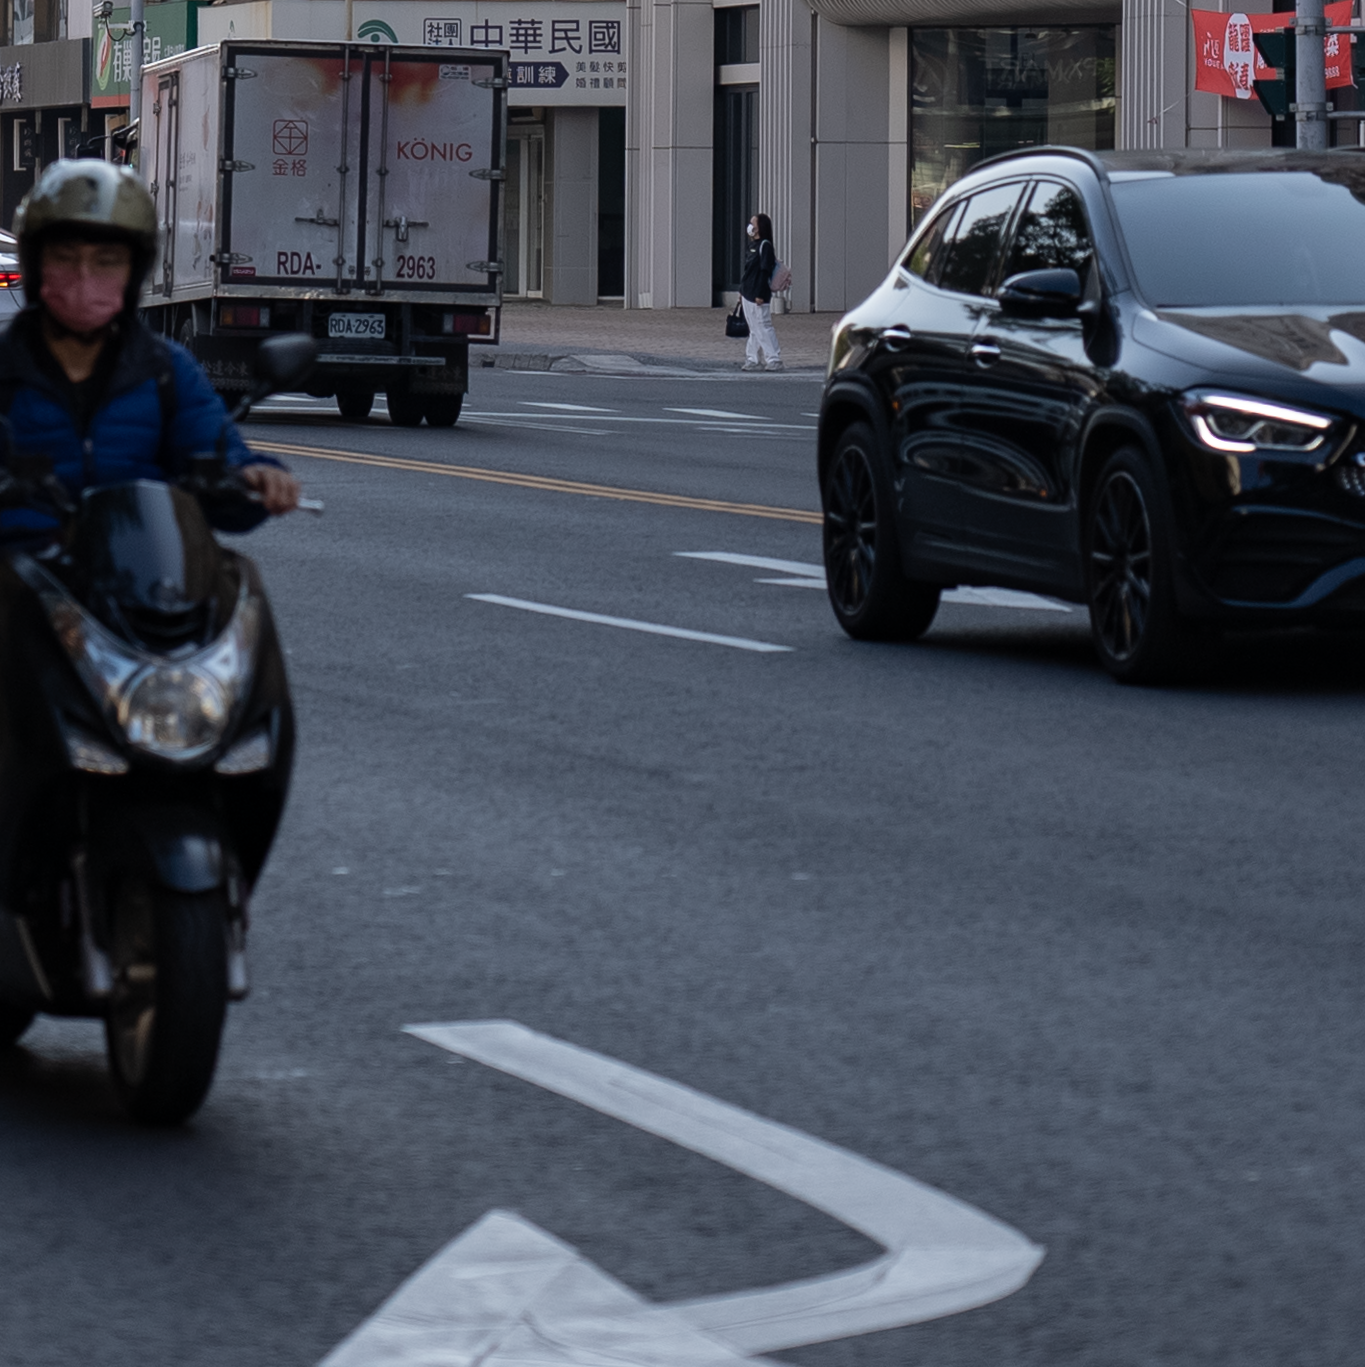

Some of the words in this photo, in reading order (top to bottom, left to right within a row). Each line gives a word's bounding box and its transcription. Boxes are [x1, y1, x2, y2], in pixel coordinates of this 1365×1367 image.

[470, 18, 621, 54] 中華民國
[397, 137, 473, 162] KÖNIG
[272, 159, 307, 177] 金格
[277, 251, 322, 276] RDA-
[396, 255, 436, 280] 2963
[329, 318, 384, 333] RDA-2963
